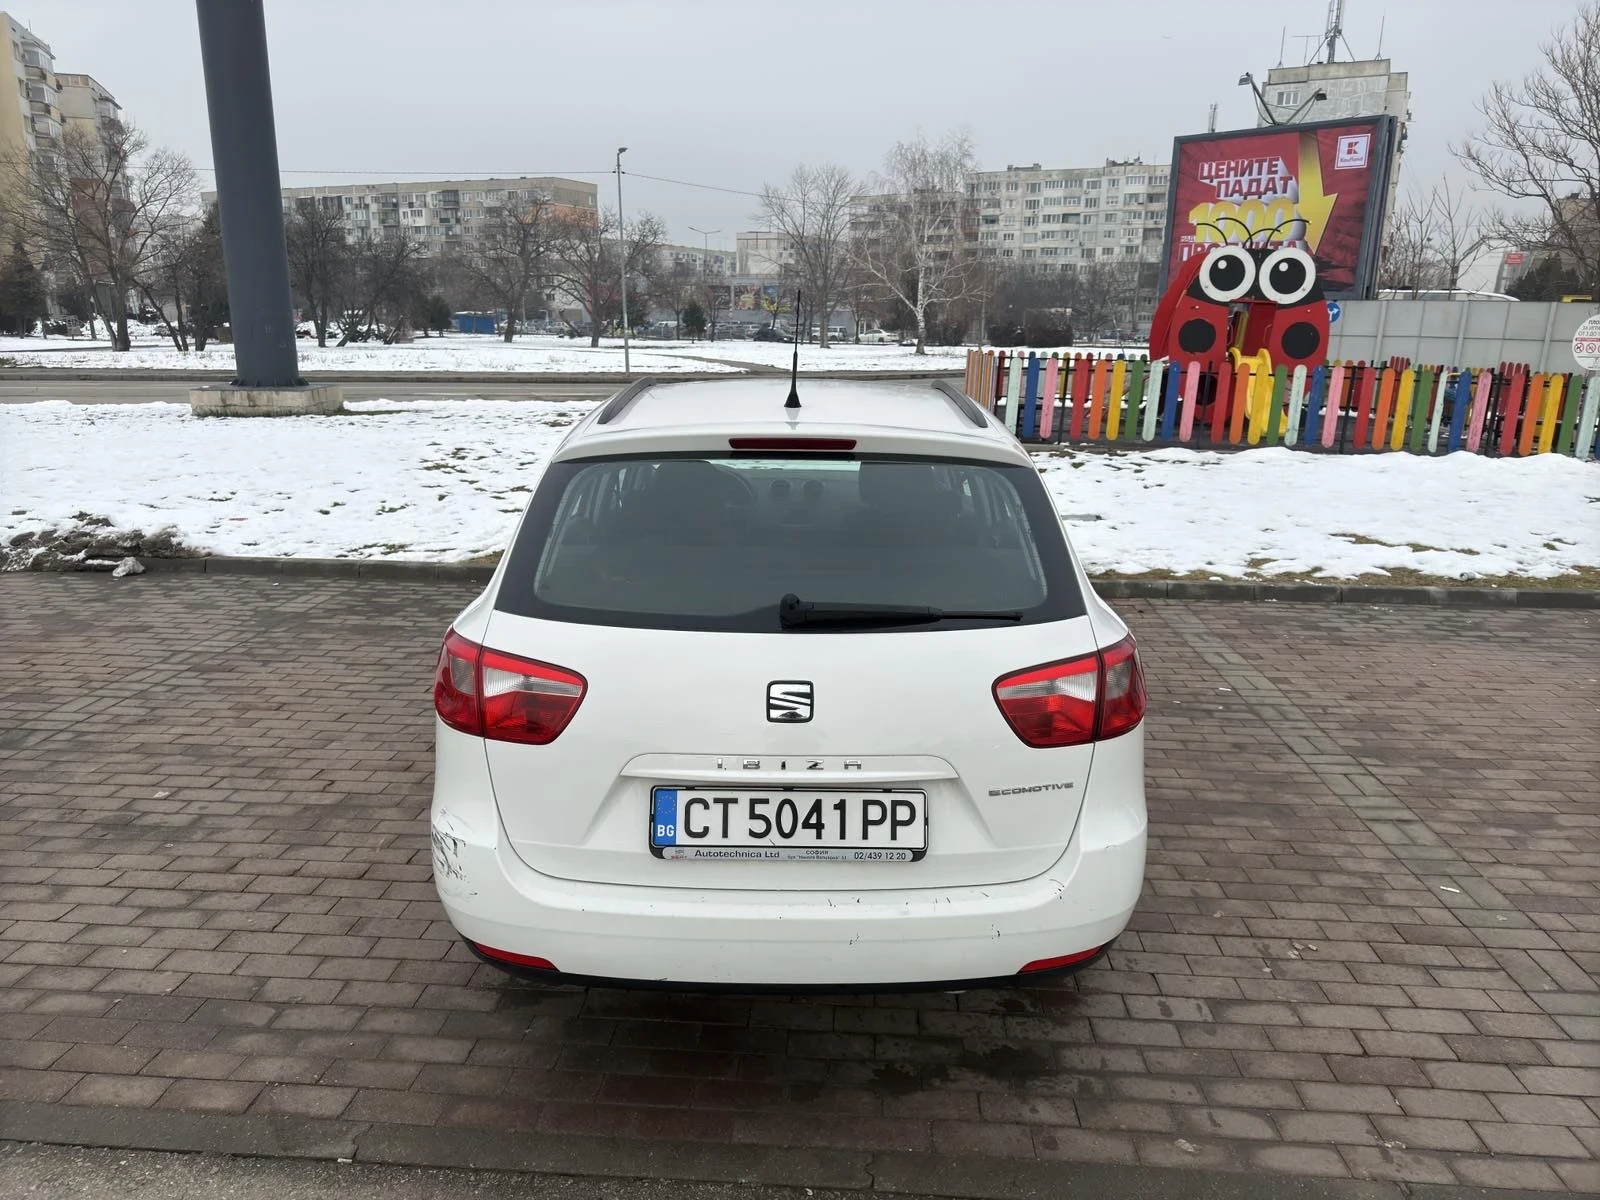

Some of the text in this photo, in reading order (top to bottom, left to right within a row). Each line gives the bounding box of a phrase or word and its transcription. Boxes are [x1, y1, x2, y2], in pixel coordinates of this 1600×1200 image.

[1199, 156, 1281, 184] ЦЕНИТЕ
[1216, 175, 1294, 201] ПАДАТ
[1188, 198, 1296, 243] 1000
[717, 759, 862, 770] IBIZA
[988, 782, 1074, 797] ECOMOTIVE
[684, 797, 916, 841] CT 5041 PP
[657, 824, 675, 837] BG
[694, 849, 780, 858] Autotechnica Ltd
[854, 851, 883, 860] 02/439
[885, 852, 894, 860] 12
[896, 852, 906, 860] 20
